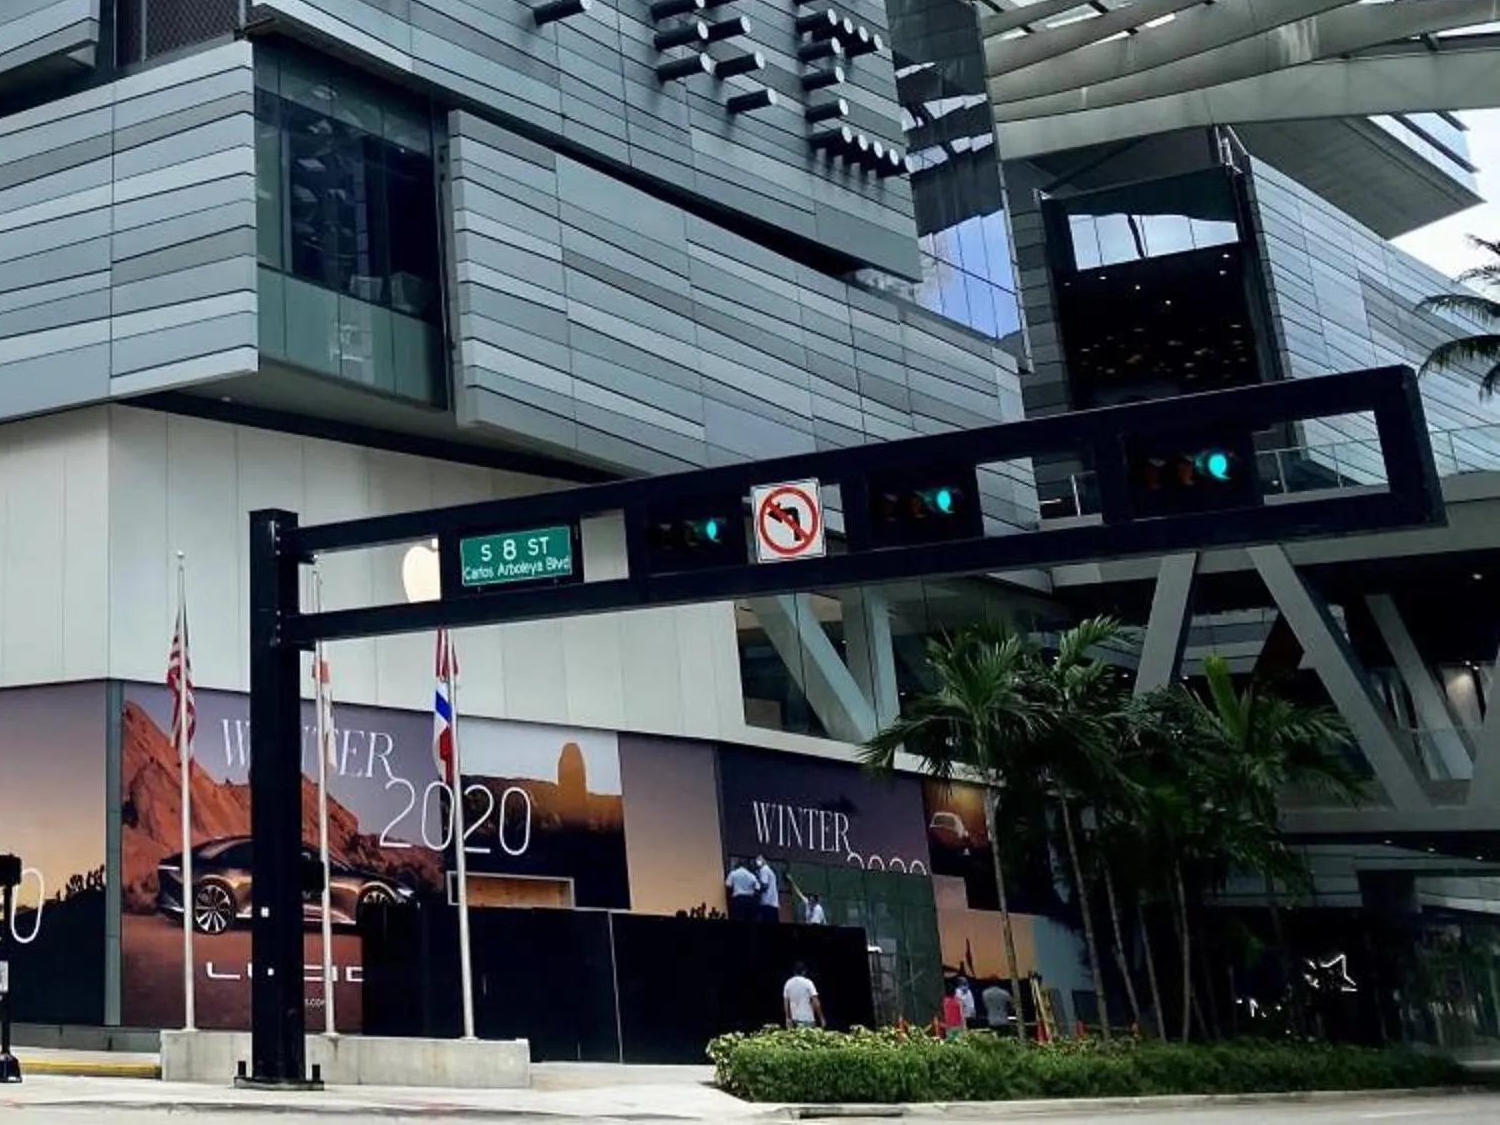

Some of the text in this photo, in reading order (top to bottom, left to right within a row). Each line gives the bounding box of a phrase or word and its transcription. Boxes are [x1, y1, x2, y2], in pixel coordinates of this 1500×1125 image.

[481, 537, 549, 562] S 8 ST
[465, 566, 494, 580] Carlos
[498, 559, 543, 576] Arboleya
[379, 778, 531, 855] 2020
[753, 801, 850, 854] WINTER
